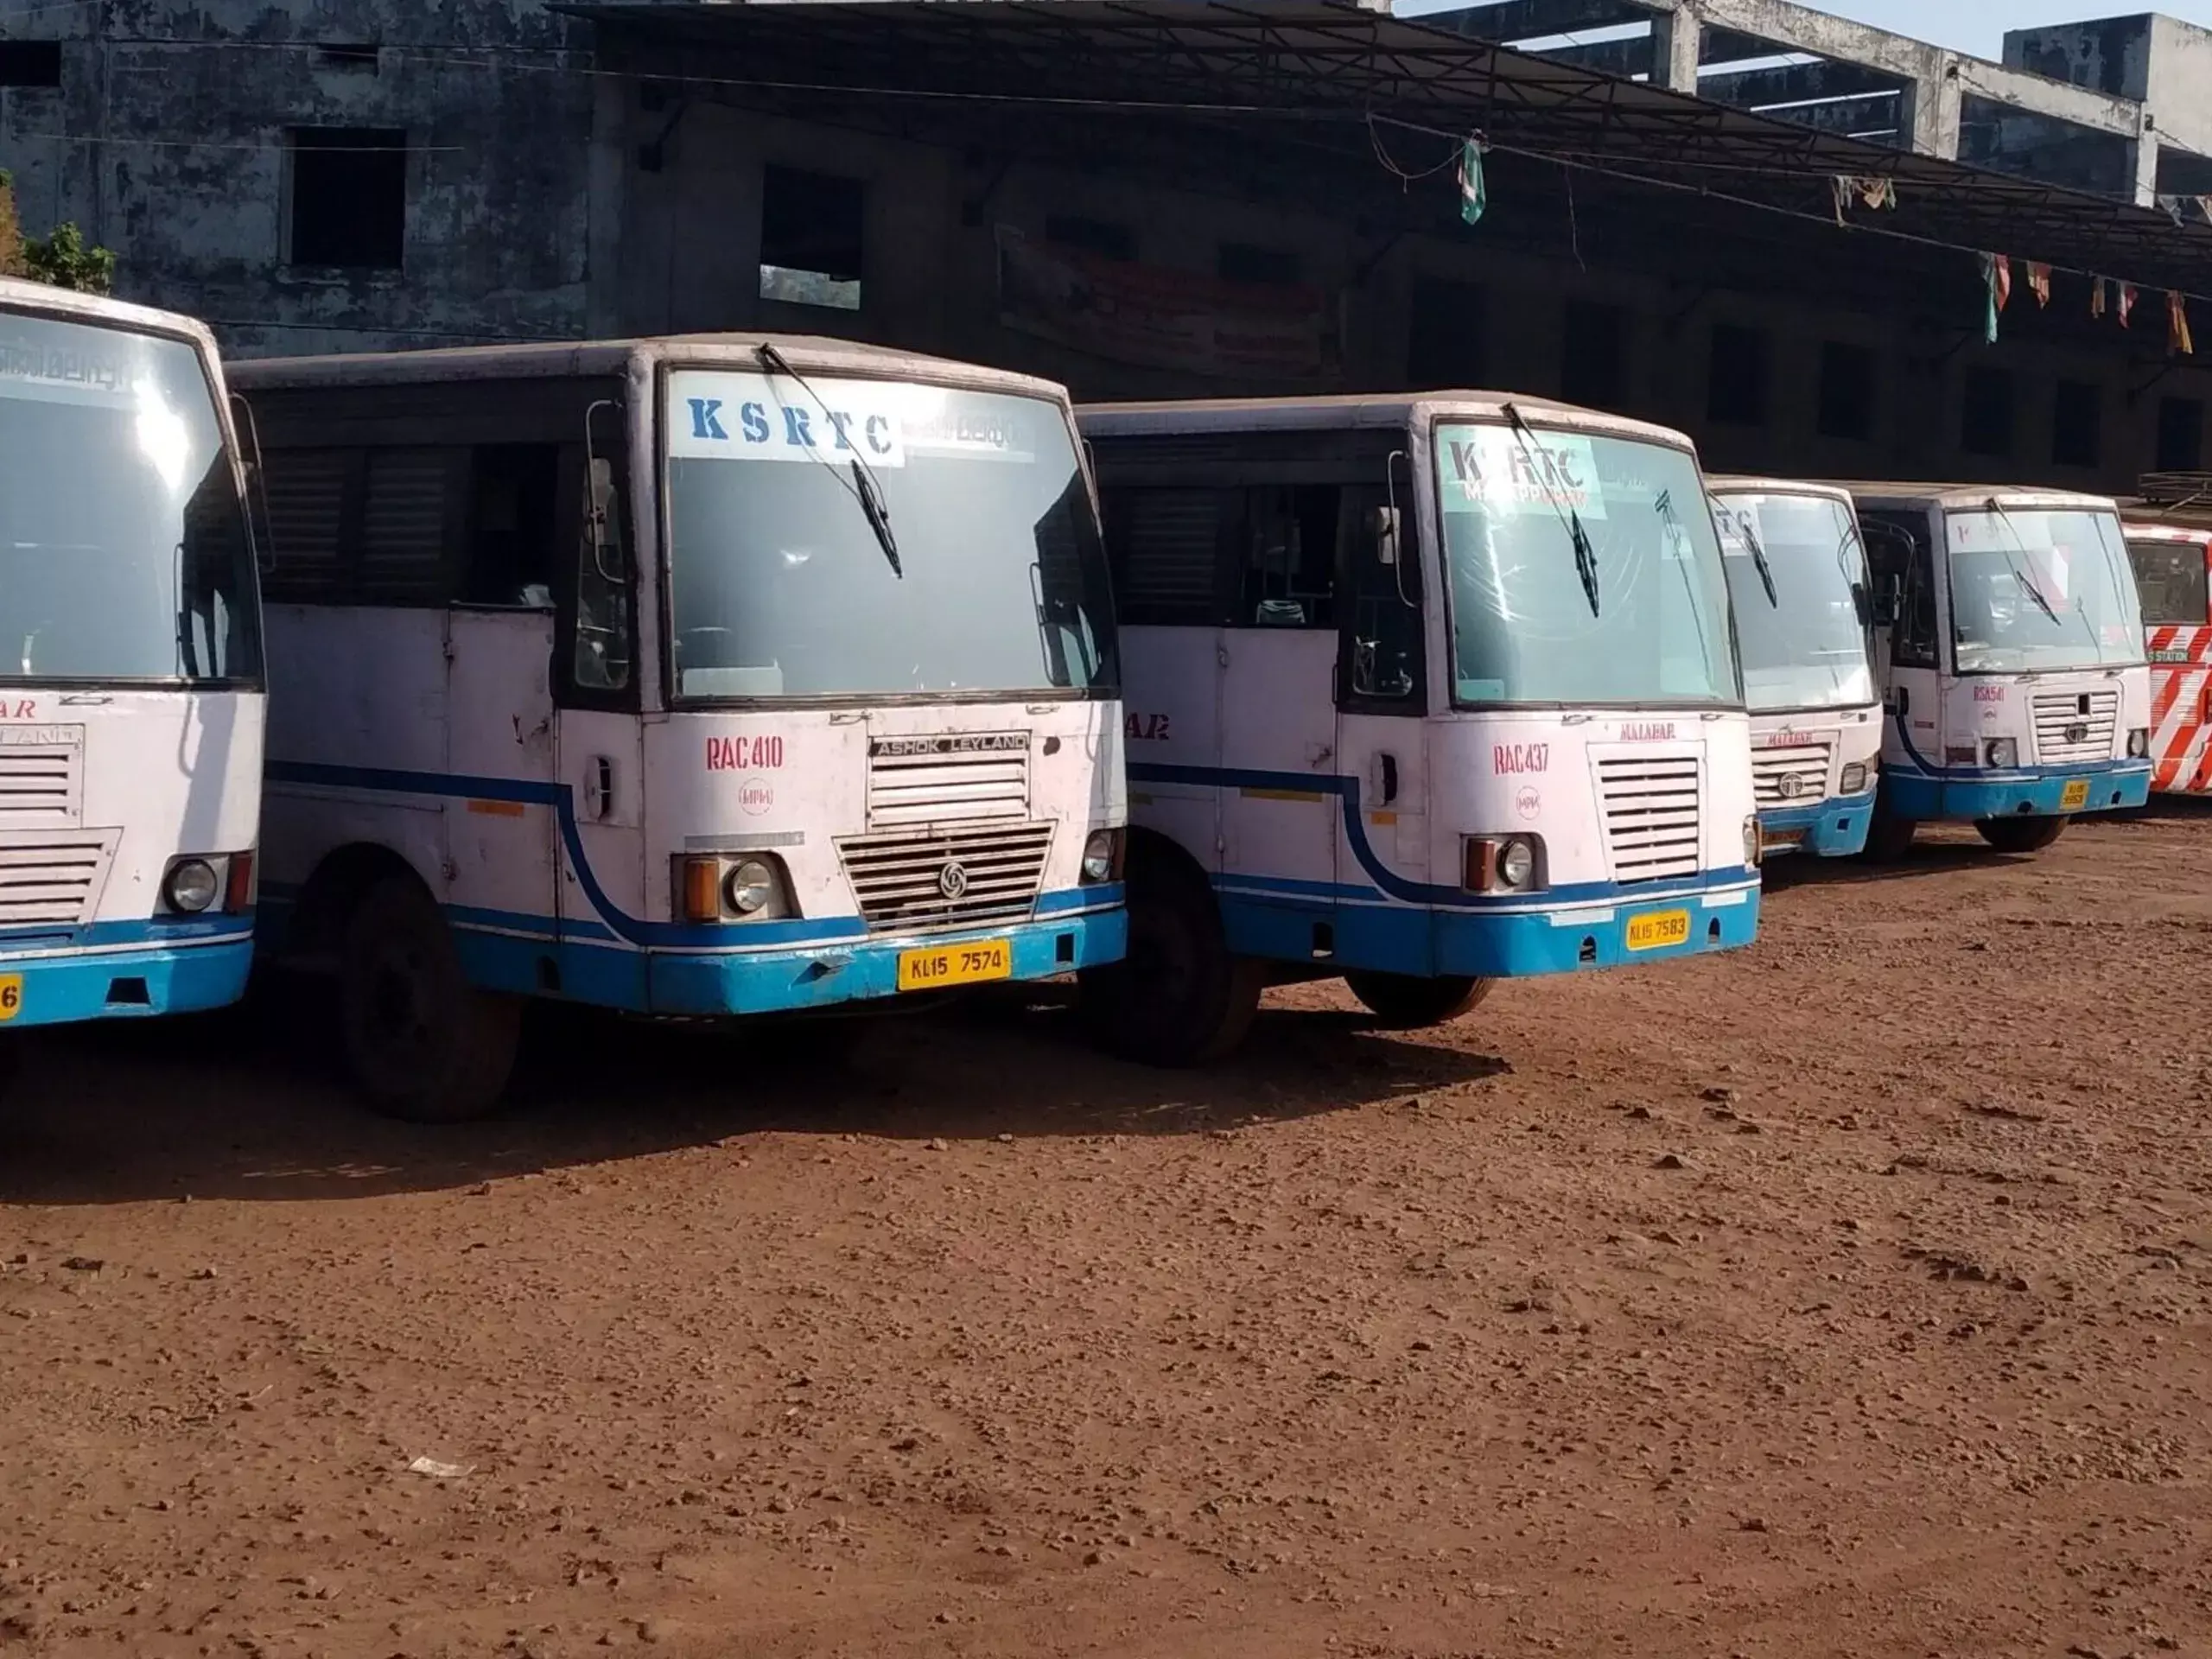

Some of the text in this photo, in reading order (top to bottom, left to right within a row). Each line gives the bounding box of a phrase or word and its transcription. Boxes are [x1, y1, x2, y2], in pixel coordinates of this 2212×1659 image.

[687, 398, 892, 454] KSRTC
[1449, 440, 1583, 488] KRTC
[878, 734, 1027, 756] ASHOK LEYLAND
[1656, 918, 1686, 939] 7583
[960, 950, 1001, 973] 7574
[2, 985, 17, 1010] 6
